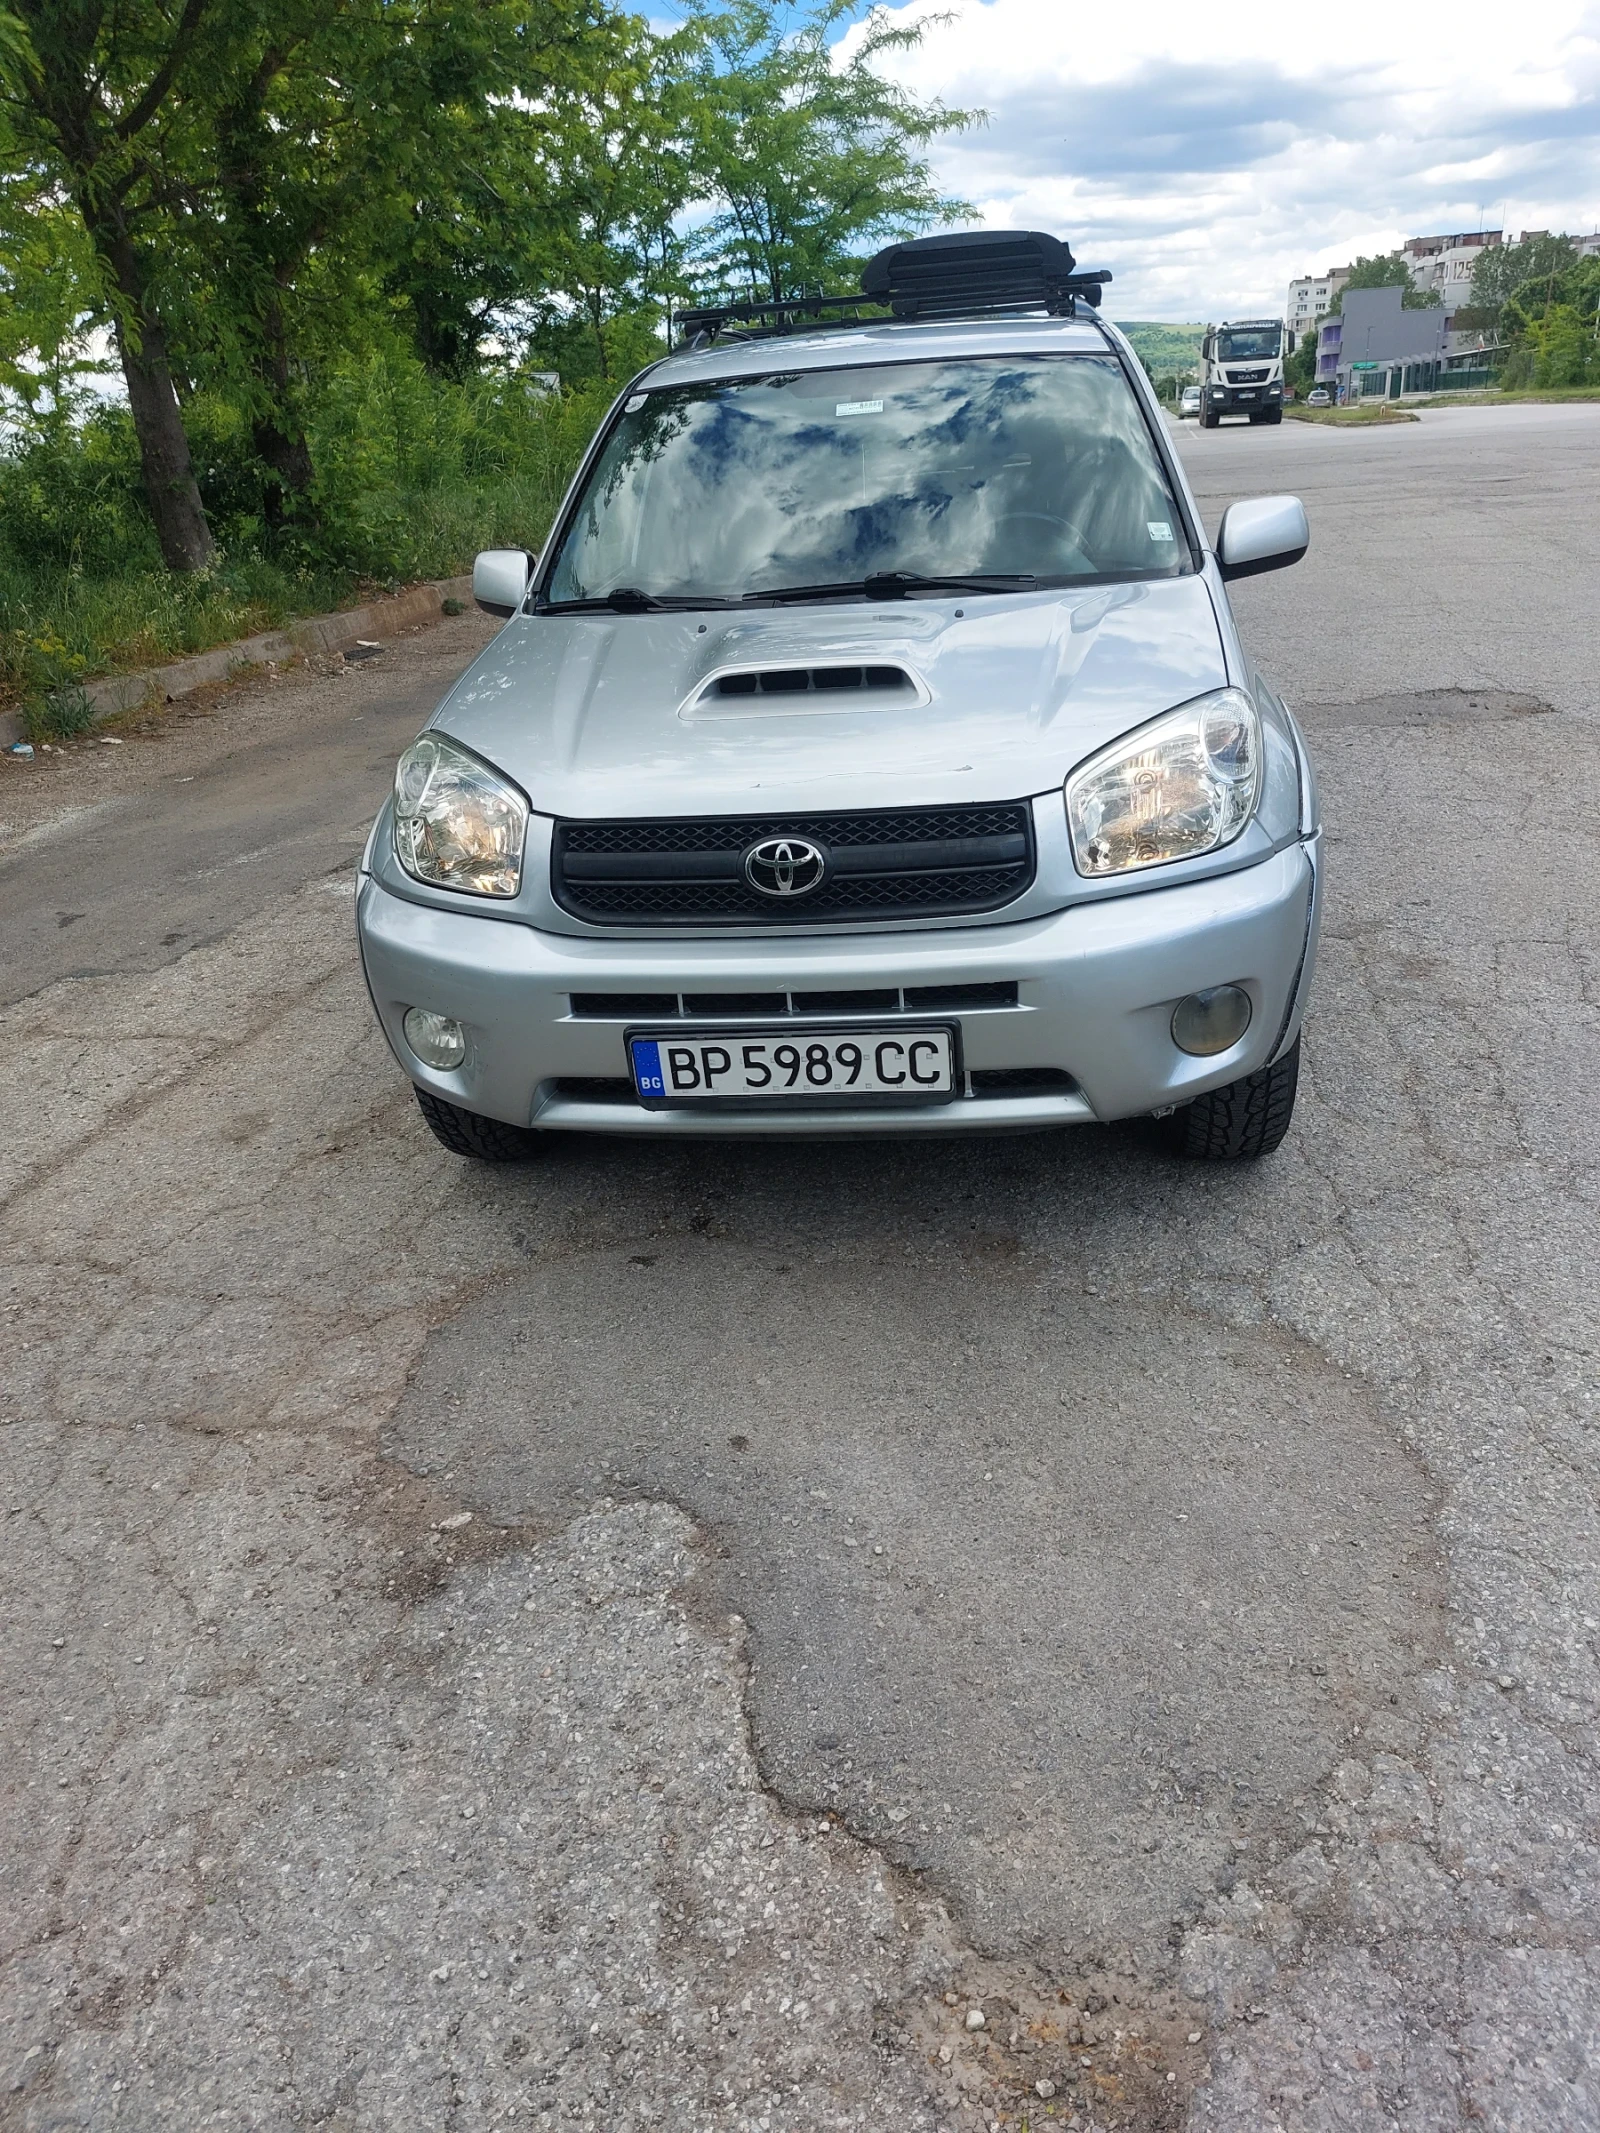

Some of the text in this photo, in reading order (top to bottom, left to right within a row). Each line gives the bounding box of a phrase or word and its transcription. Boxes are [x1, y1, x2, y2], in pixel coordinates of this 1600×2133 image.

[667, 1041, 940, 1090] BP 5989 CC
[641, 1077, 661, 1089] BG
